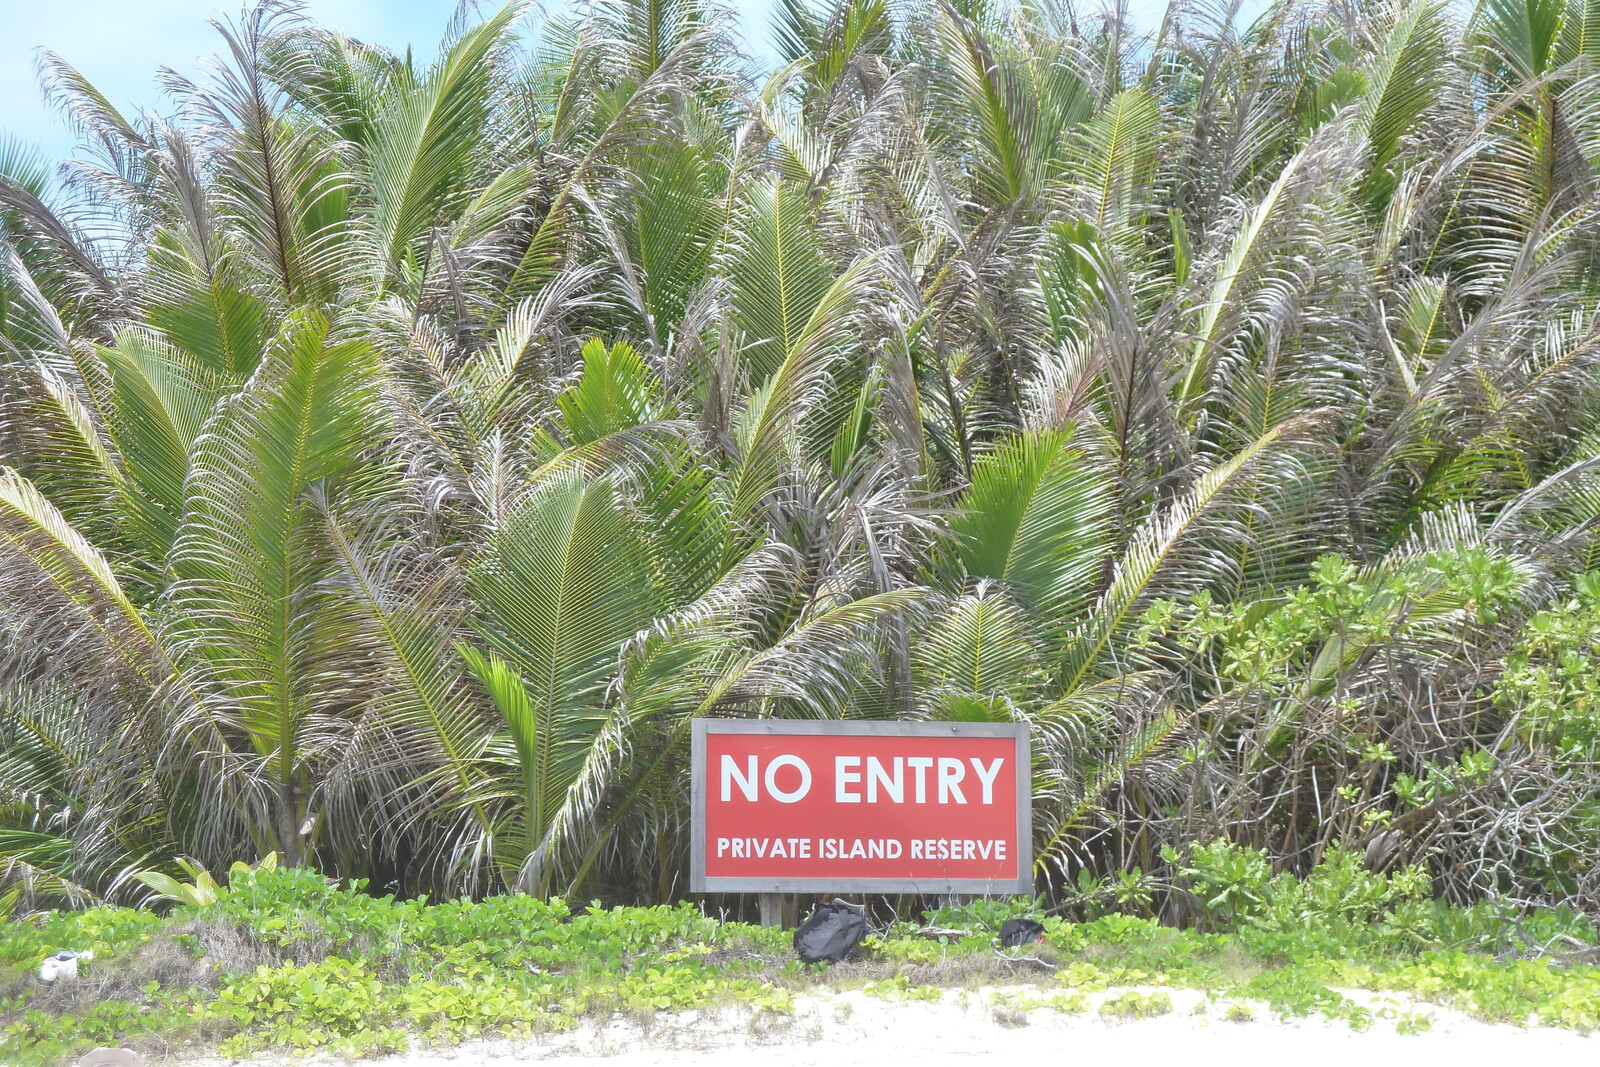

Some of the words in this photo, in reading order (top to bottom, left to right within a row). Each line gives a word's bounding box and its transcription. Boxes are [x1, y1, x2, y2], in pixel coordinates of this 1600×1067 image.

[720, 754, 812, 804] NO
[835, 756, 1005, 805] ENTRY
[717, 838, 811, 858] PRIVATE
[819, 838, 902, 859] ISLAND
[910, 839, 1007, 860] RESERVE
